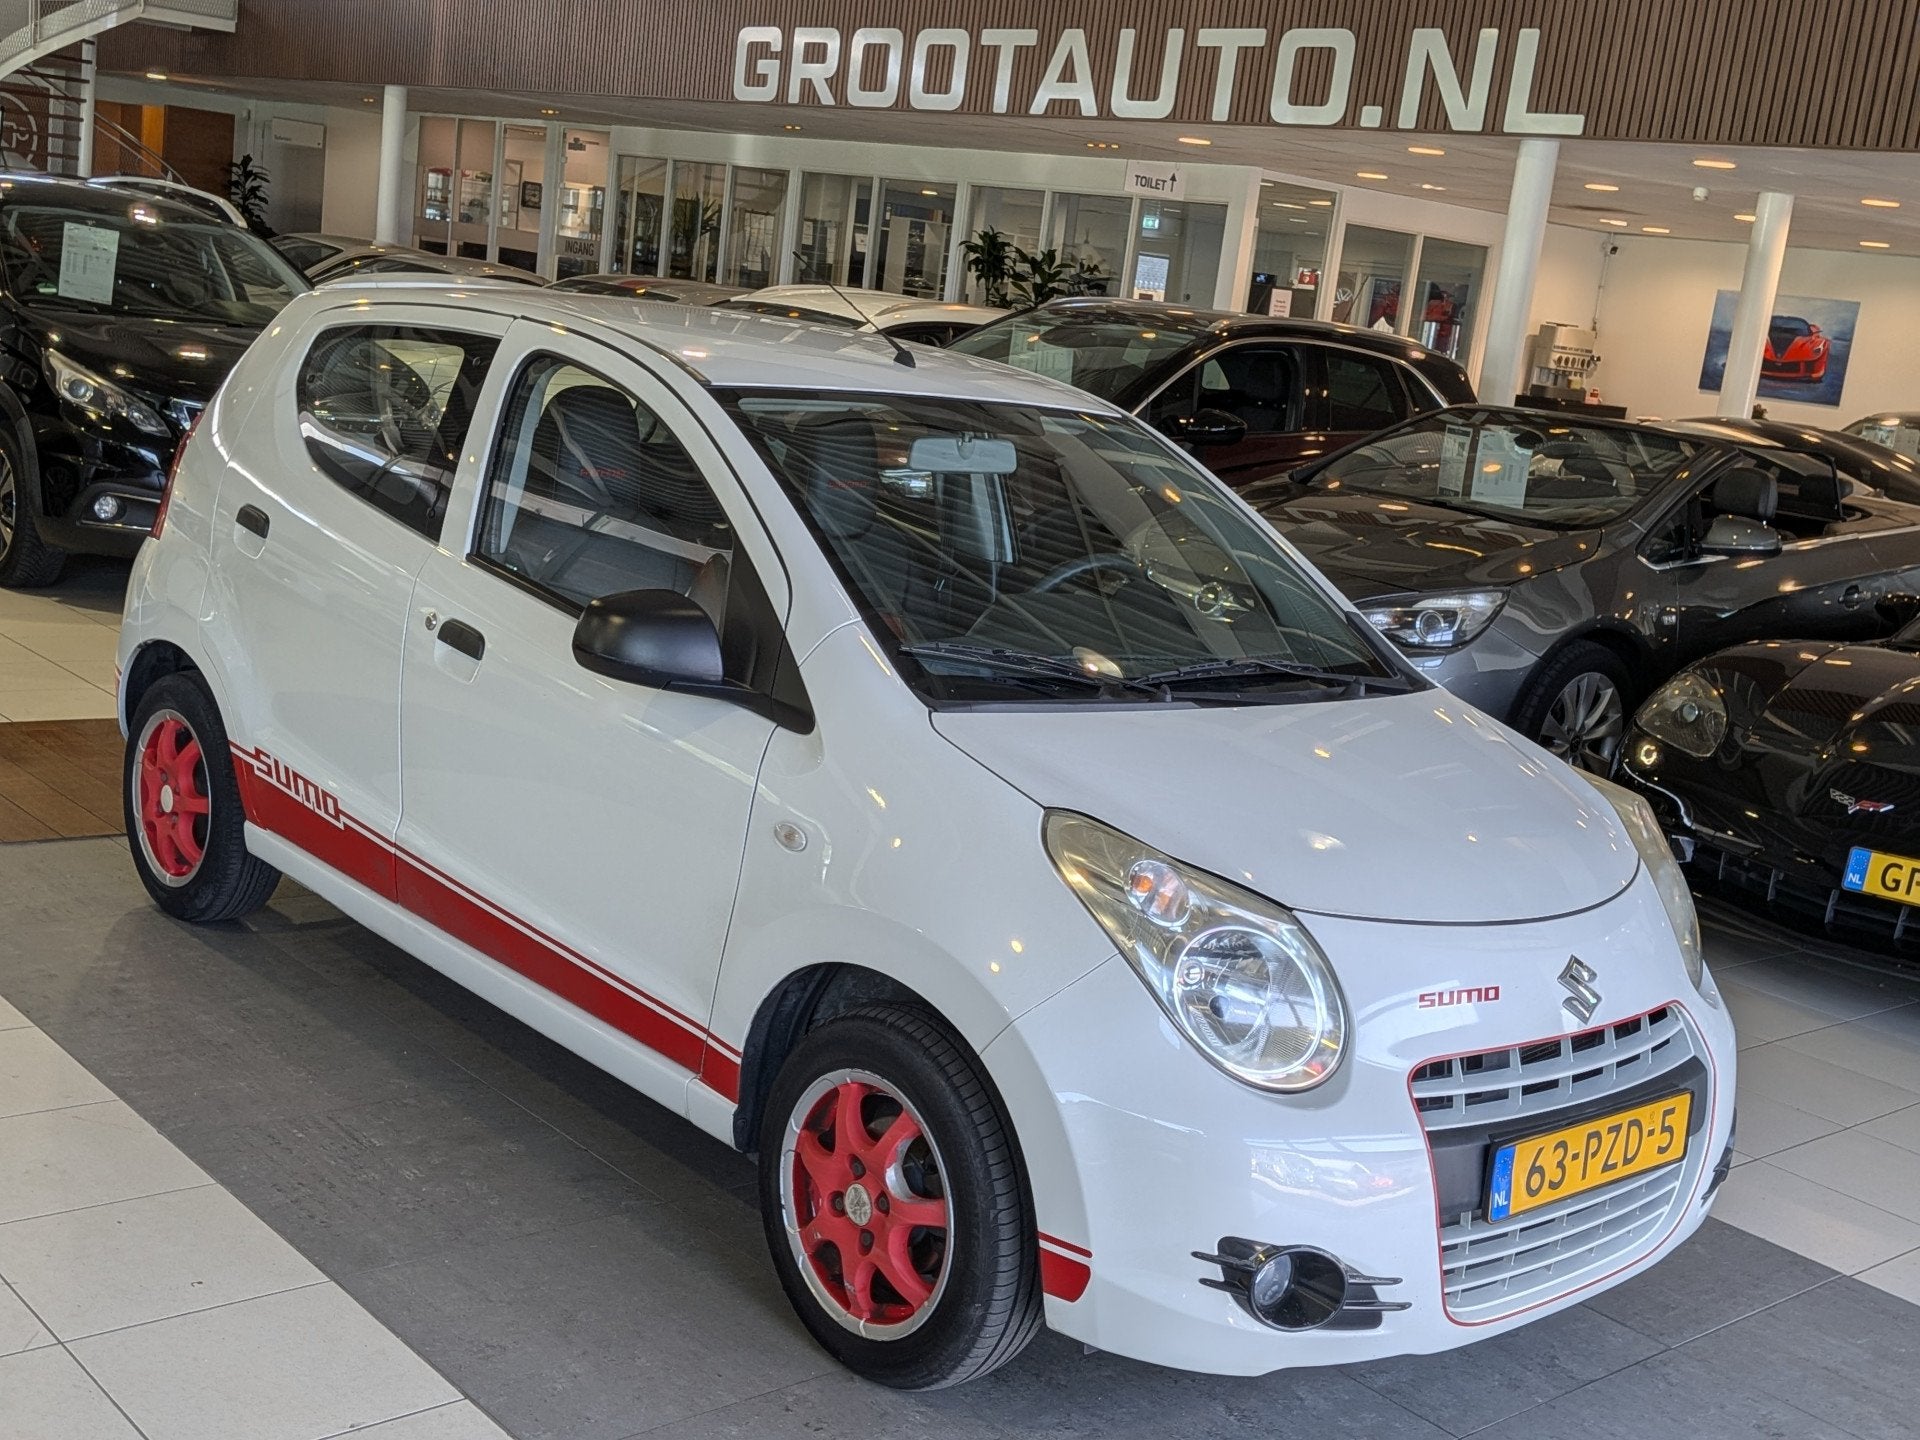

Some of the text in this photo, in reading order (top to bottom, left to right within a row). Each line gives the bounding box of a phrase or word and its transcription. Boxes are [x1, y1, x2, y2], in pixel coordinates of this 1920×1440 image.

[733, 26, 1585, 137] GROOTAUTO.NL
[1134, 174, 1168, 191] TOILET
[564, 239, 595, 257] INGANG
[253, 745, 342, 825] SUMO
[1847, 872, 1862, 885] NL
[1418, 985, 1500, 1009] SUMO
[1525, 1106, 1677, 1198] 63-PZD-5
[1493, 1191, 1509, 1208] NL
